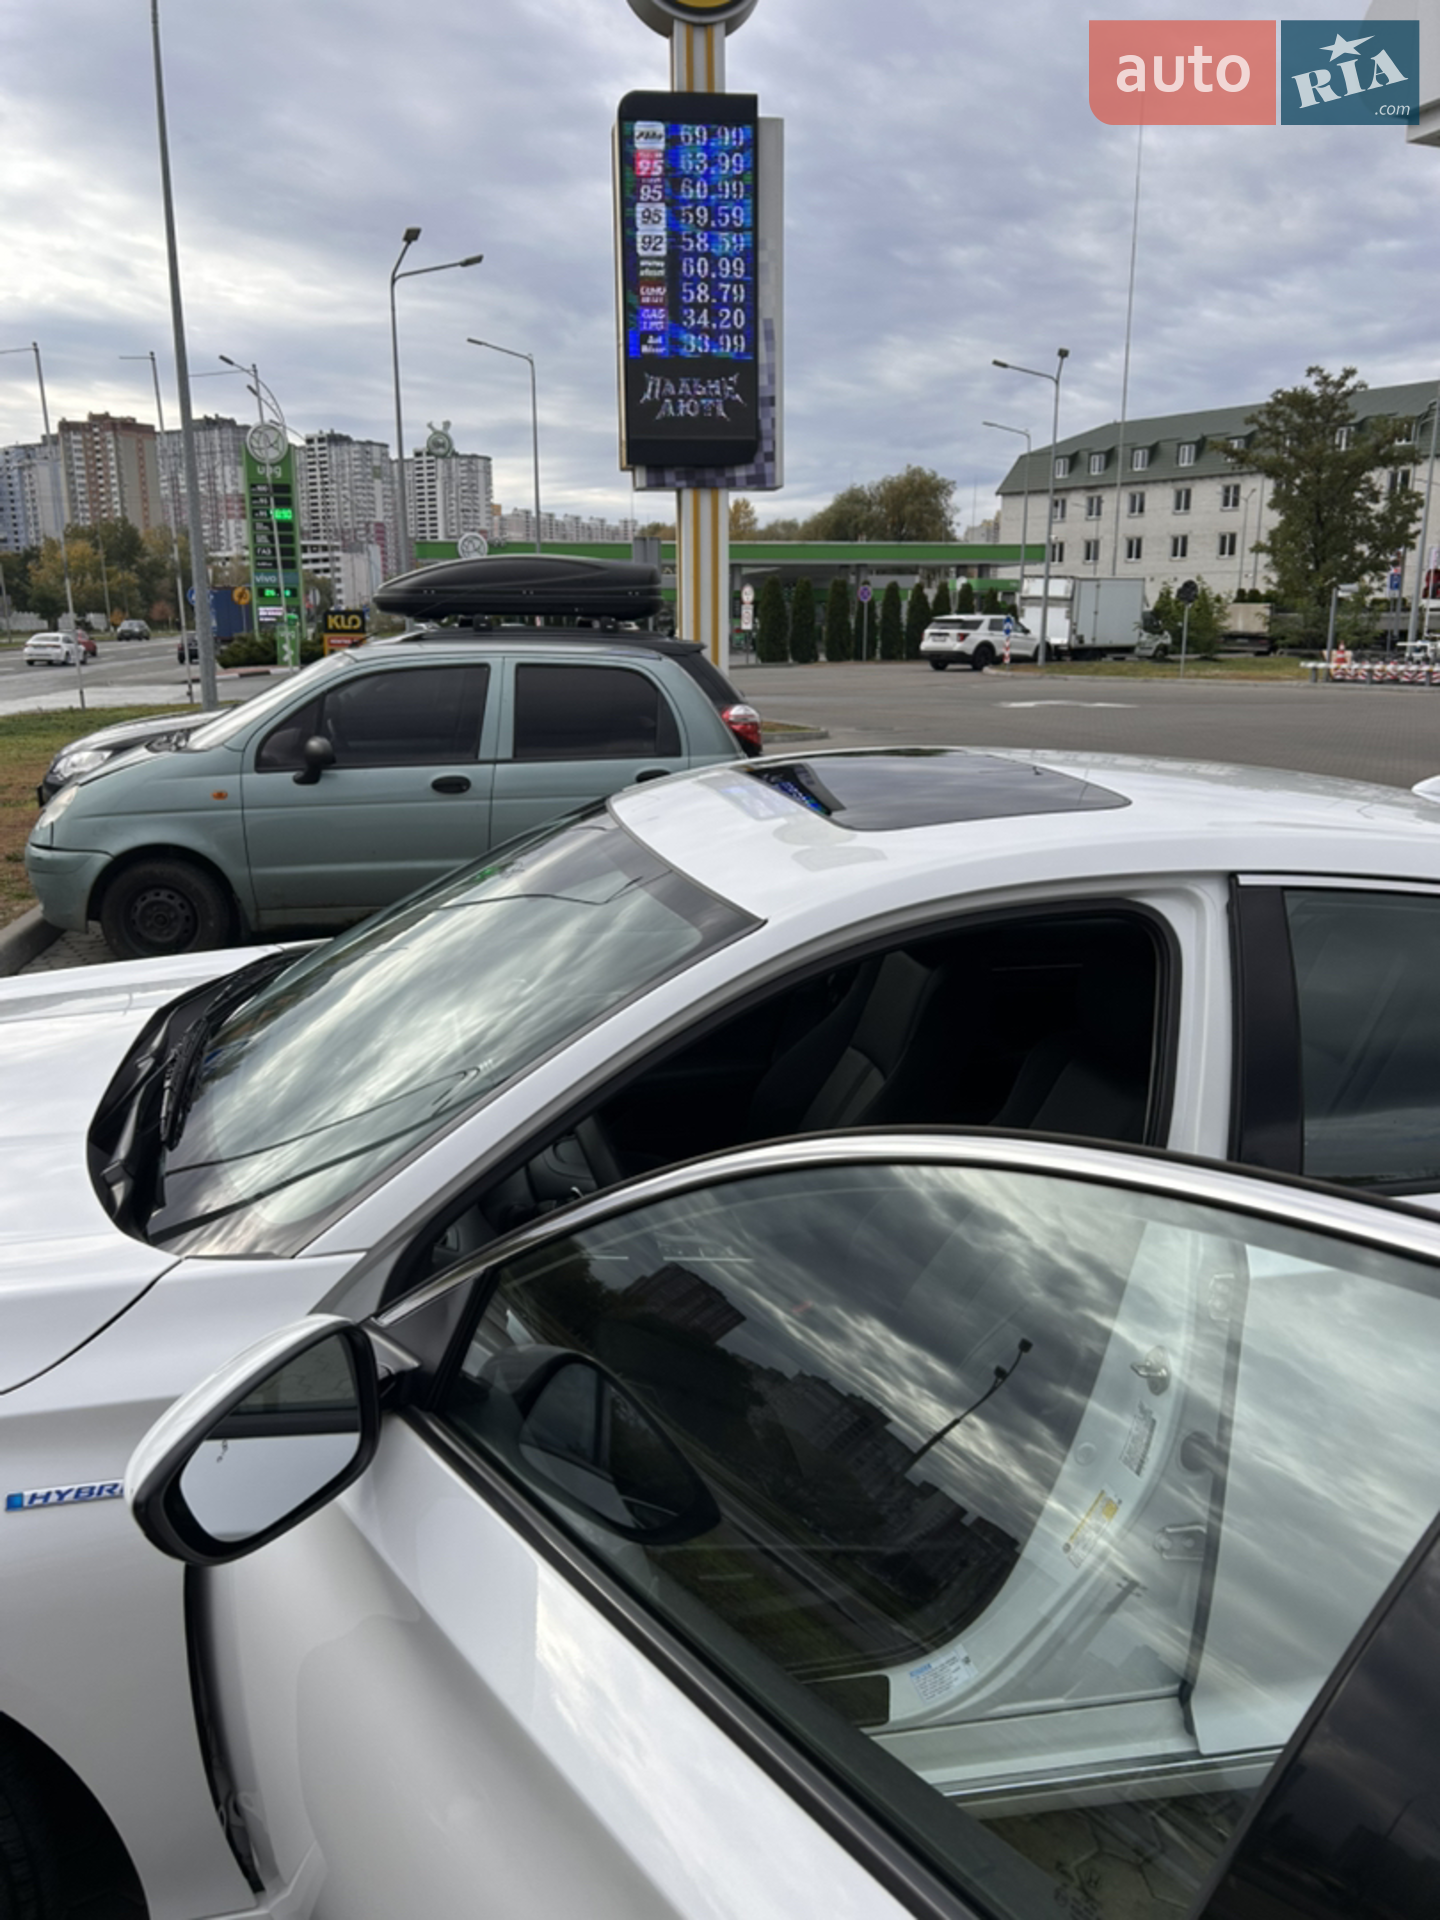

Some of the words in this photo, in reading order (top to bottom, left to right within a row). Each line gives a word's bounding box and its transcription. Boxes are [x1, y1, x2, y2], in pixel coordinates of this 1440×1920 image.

[680, 152, 744, 175] 63.99
[680, 178, 744, 199] 60.99
[641, 208, 663, 225] 95
[680, 205, 744, 227] 59.59
[641, 234, 665, 251] 92
[681, 231, 745, 252] 58.59
[682, 257, 746, 278] 60.99
[682, 282, 746, 303] 58.79
[682, 308, 746, 329] 34.20
[327, 614, 362, 630] KLO
